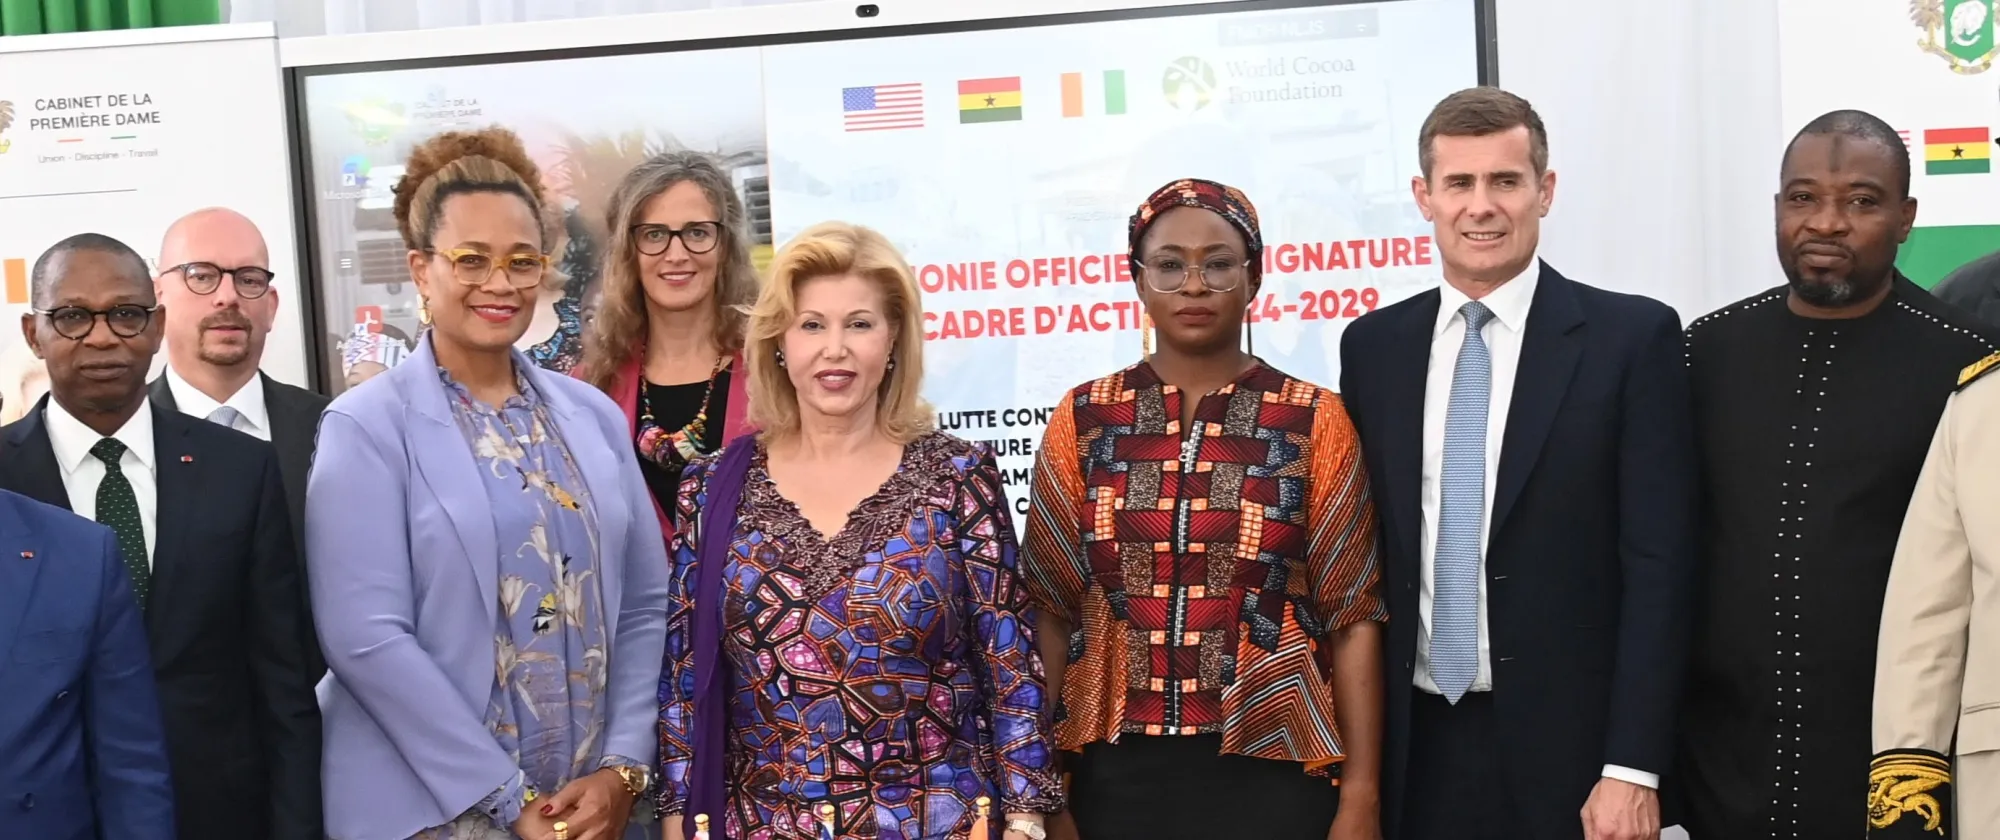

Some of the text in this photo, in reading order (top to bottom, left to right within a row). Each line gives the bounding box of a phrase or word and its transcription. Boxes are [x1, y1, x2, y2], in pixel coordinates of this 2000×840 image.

[1226, 56, 1356, 78] World Cocoa
[35, 93, 153, 111] CABINET DE LA
[1228, 81, 1343, 104] Foundation
[30, 111, 161, 131] PREMIÈRE DAME
[38, 154, 66, 164] Union
[74, 151, 119, 162] Discipline
[128, 148, 159, 158] Travail
[910, 261, 997, 293] ONIE
[939, 410, 997, 430] LUTTE
